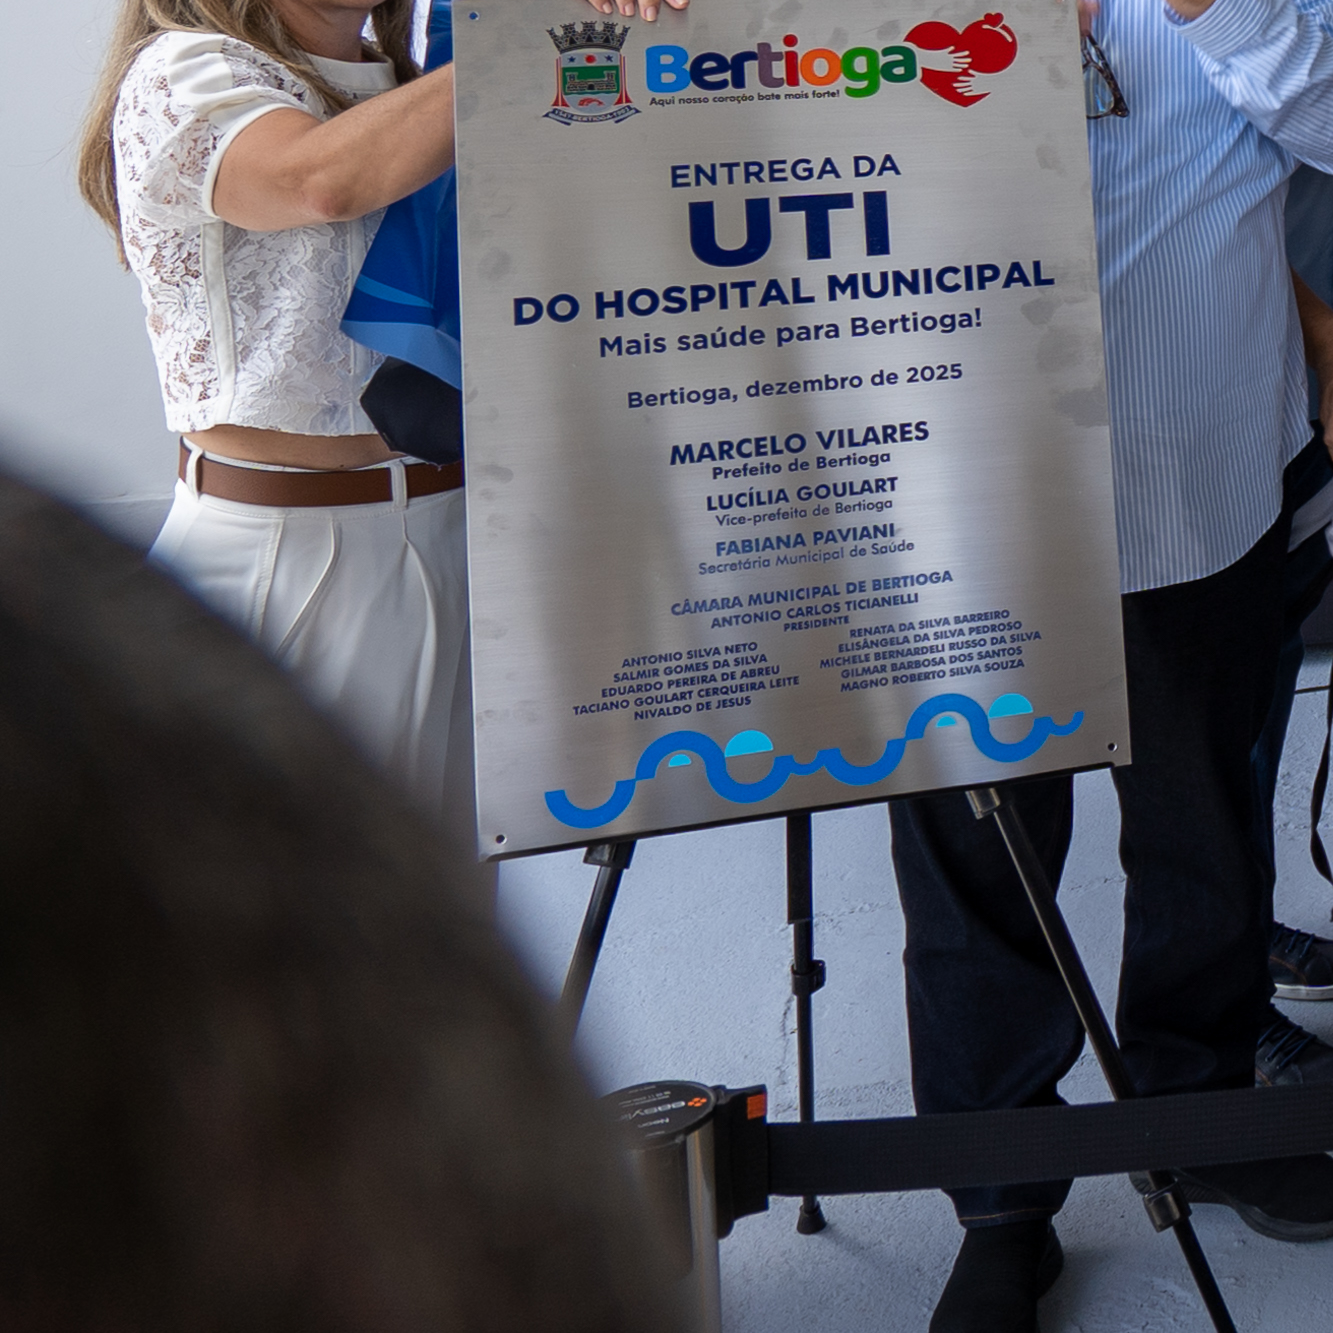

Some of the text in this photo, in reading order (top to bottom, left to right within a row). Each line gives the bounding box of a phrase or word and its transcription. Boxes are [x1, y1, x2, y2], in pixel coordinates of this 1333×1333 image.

[645, 33, 918, 99] Bertioga
[649, 95, 675, 107] Aqui
[757, 92, 781, 101] bate
[811, 89, 840, 98] forte!
[670, 153, 901, 188] ENTREGA DA
[688, 190, 890, 267] UTI
[513, 260, 1055, 325] DO HOSPITAL MUNICIPAL
[599, 307, 981, 357] Mais saúde para Bertioga!
[627, 362, 962, 410] Bertioga, dezembro de 2025
[669, 420, 929, 465] MARCELO VILARES
[712, 452, 890, 480] Prefeito de Bertioga
[706, 476, 898, 511] LUCÍLIA GOULART
[715, 500, 892, 526] Vice-prefeita de Bertioga
[698, 539, 914, 575] Secretária Municipal de Saúde
[716, 522, 895, 557] FABIANA PAVIANI
[670, 570, 953, 616] CÂMARA MUNICIPAL DE BERTIOGA
[710, 592, 918, 629] ANTONIO CARLOS TICIANELLI
[783, 615, 849, 632] PRESIDENTE
[621, 641, 758, 668] ANTONIO SILVA NETO
